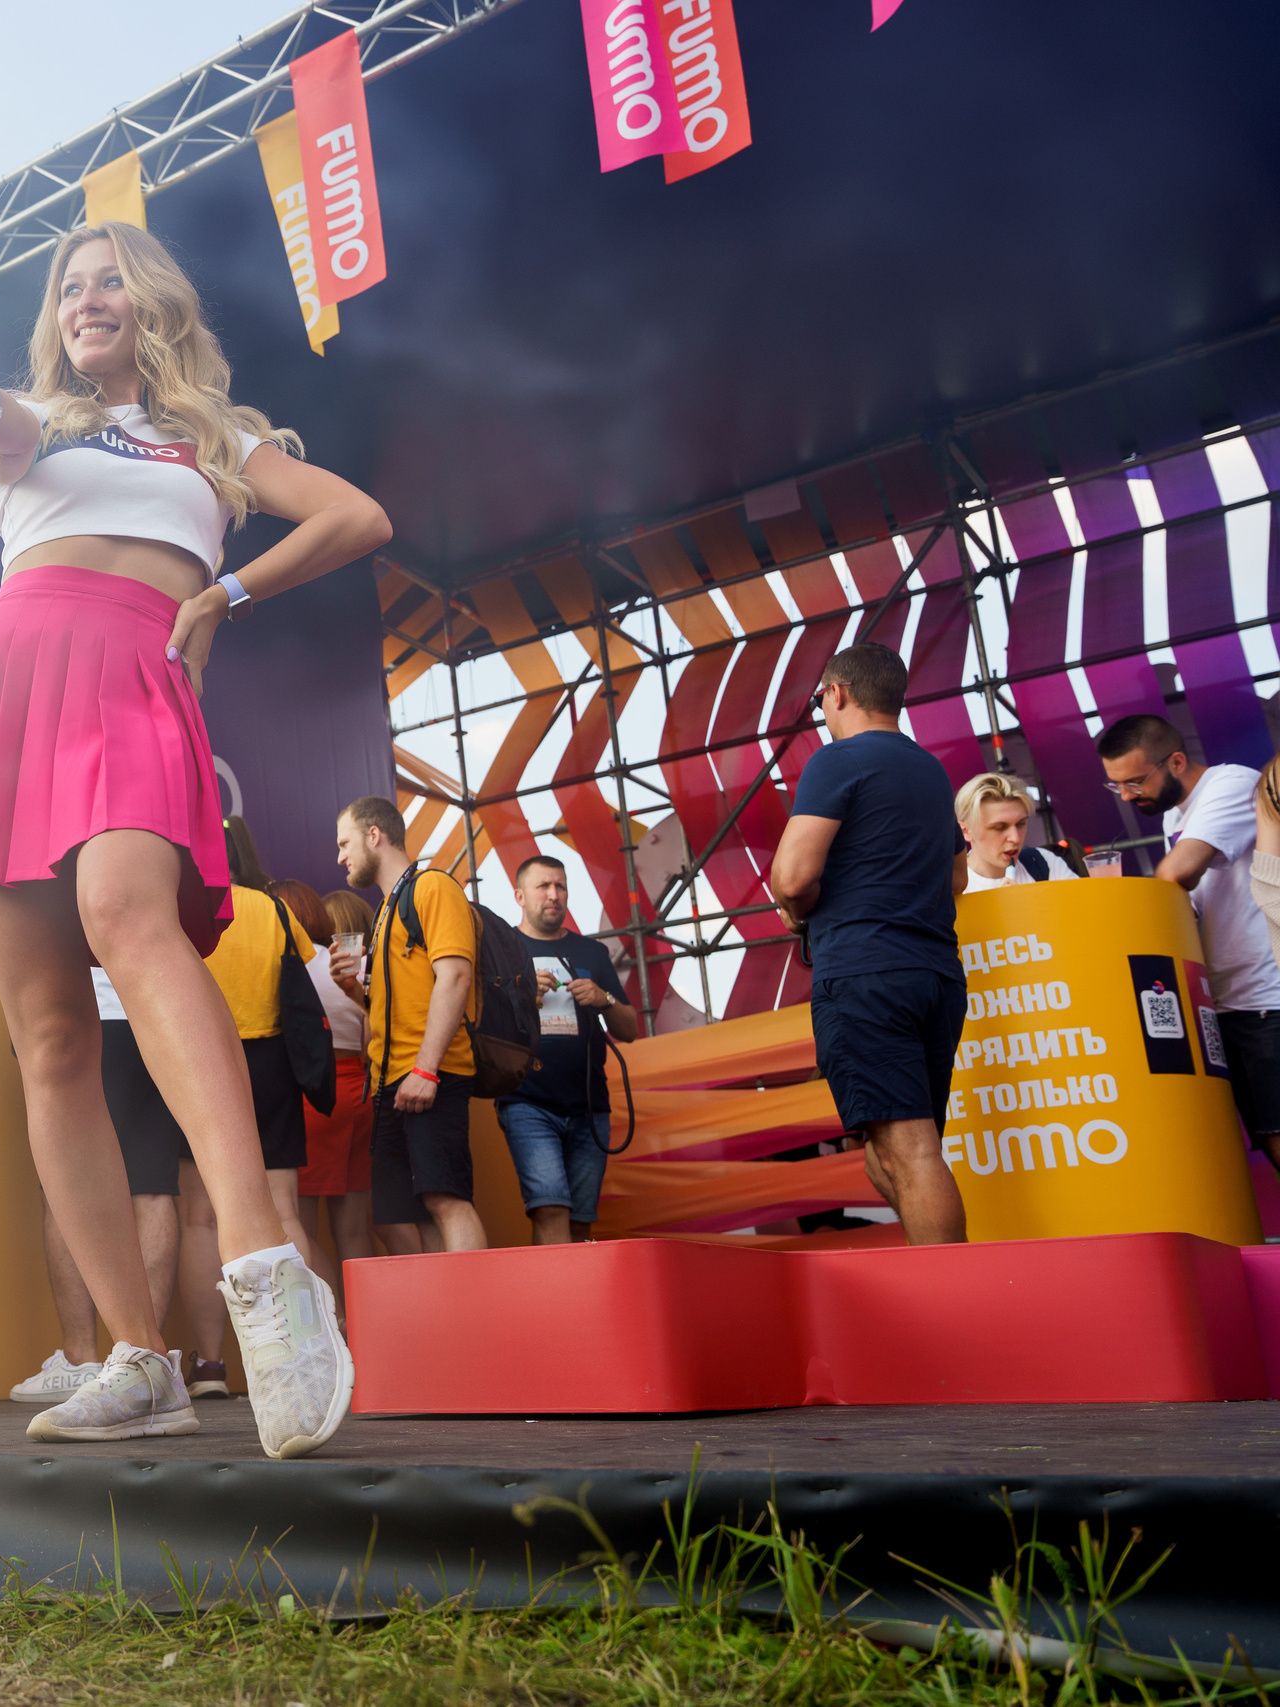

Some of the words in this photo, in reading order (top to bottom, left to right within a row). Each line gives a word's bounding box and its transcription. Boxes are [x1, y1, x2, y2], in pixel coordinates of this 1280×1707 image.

[604, 0, 662, 140] UMO
[960, 933, 1054, 978] ДЕСЬ
[965, 980, 1072, 1021] ОЖНО
[953, 1026, 1108, 1072] РЯДИТЬ
[945, 1089, 968, 1121] Е
[972, 1073, 1119, 1116] ТОЛЬКО
[41, 1371, 97, 1390] KENZO
